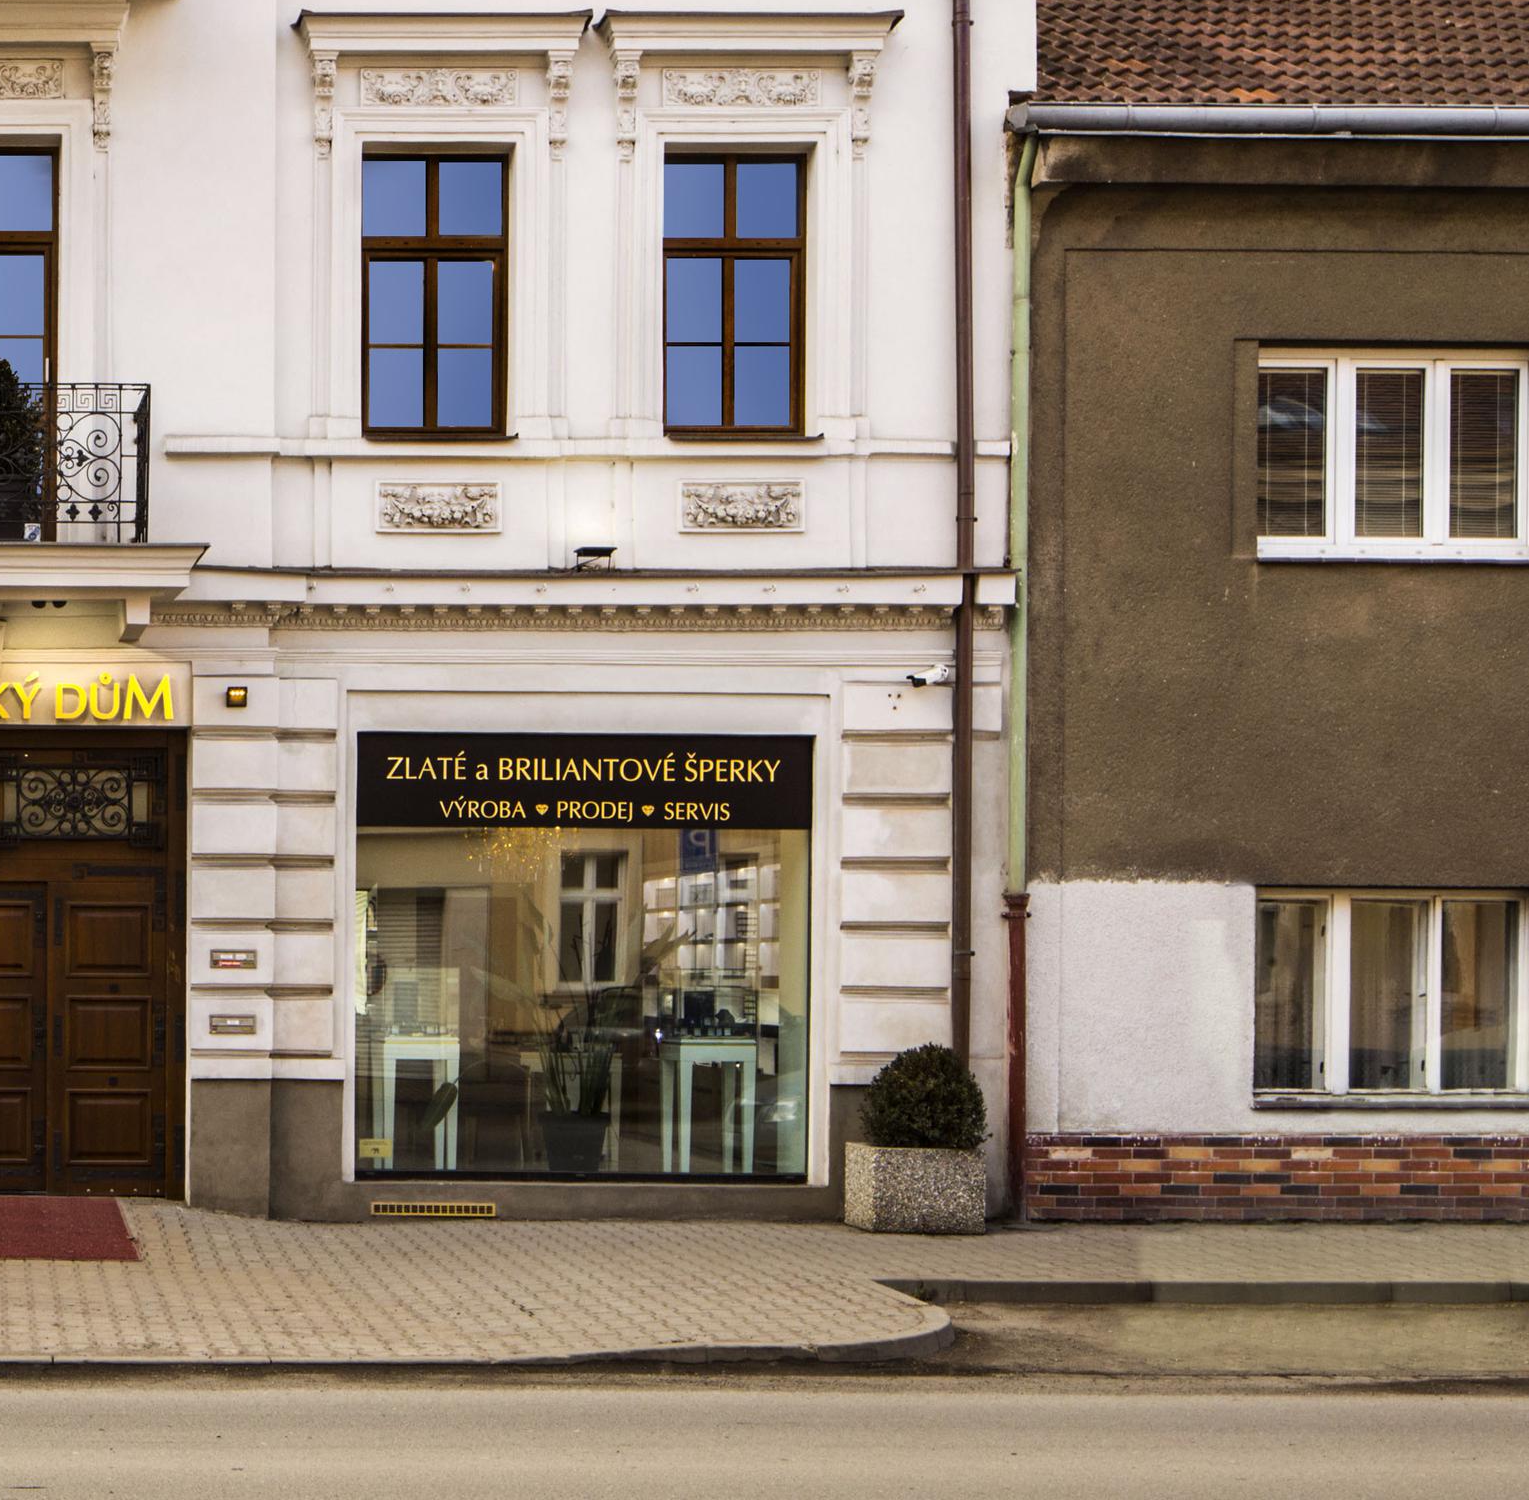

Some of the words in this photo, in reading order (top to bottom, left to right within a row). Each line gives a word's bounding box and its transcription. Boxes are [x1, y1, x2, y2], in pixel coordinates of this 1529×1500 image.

[55, 672, 174, 721] DŮM
[386, 750, 467, 780] ZLATÉ
[475, 763, 489, 781] a
[498, 752, 676, 782] BRILIANTOVÉ
[684, 752, 781, 783] ŠPERKY
[439, 795, 527, 819] VÝROBA
[556, 800, 633, 823] PRODEJ
[663, 801, 731, 821] SERVIS
